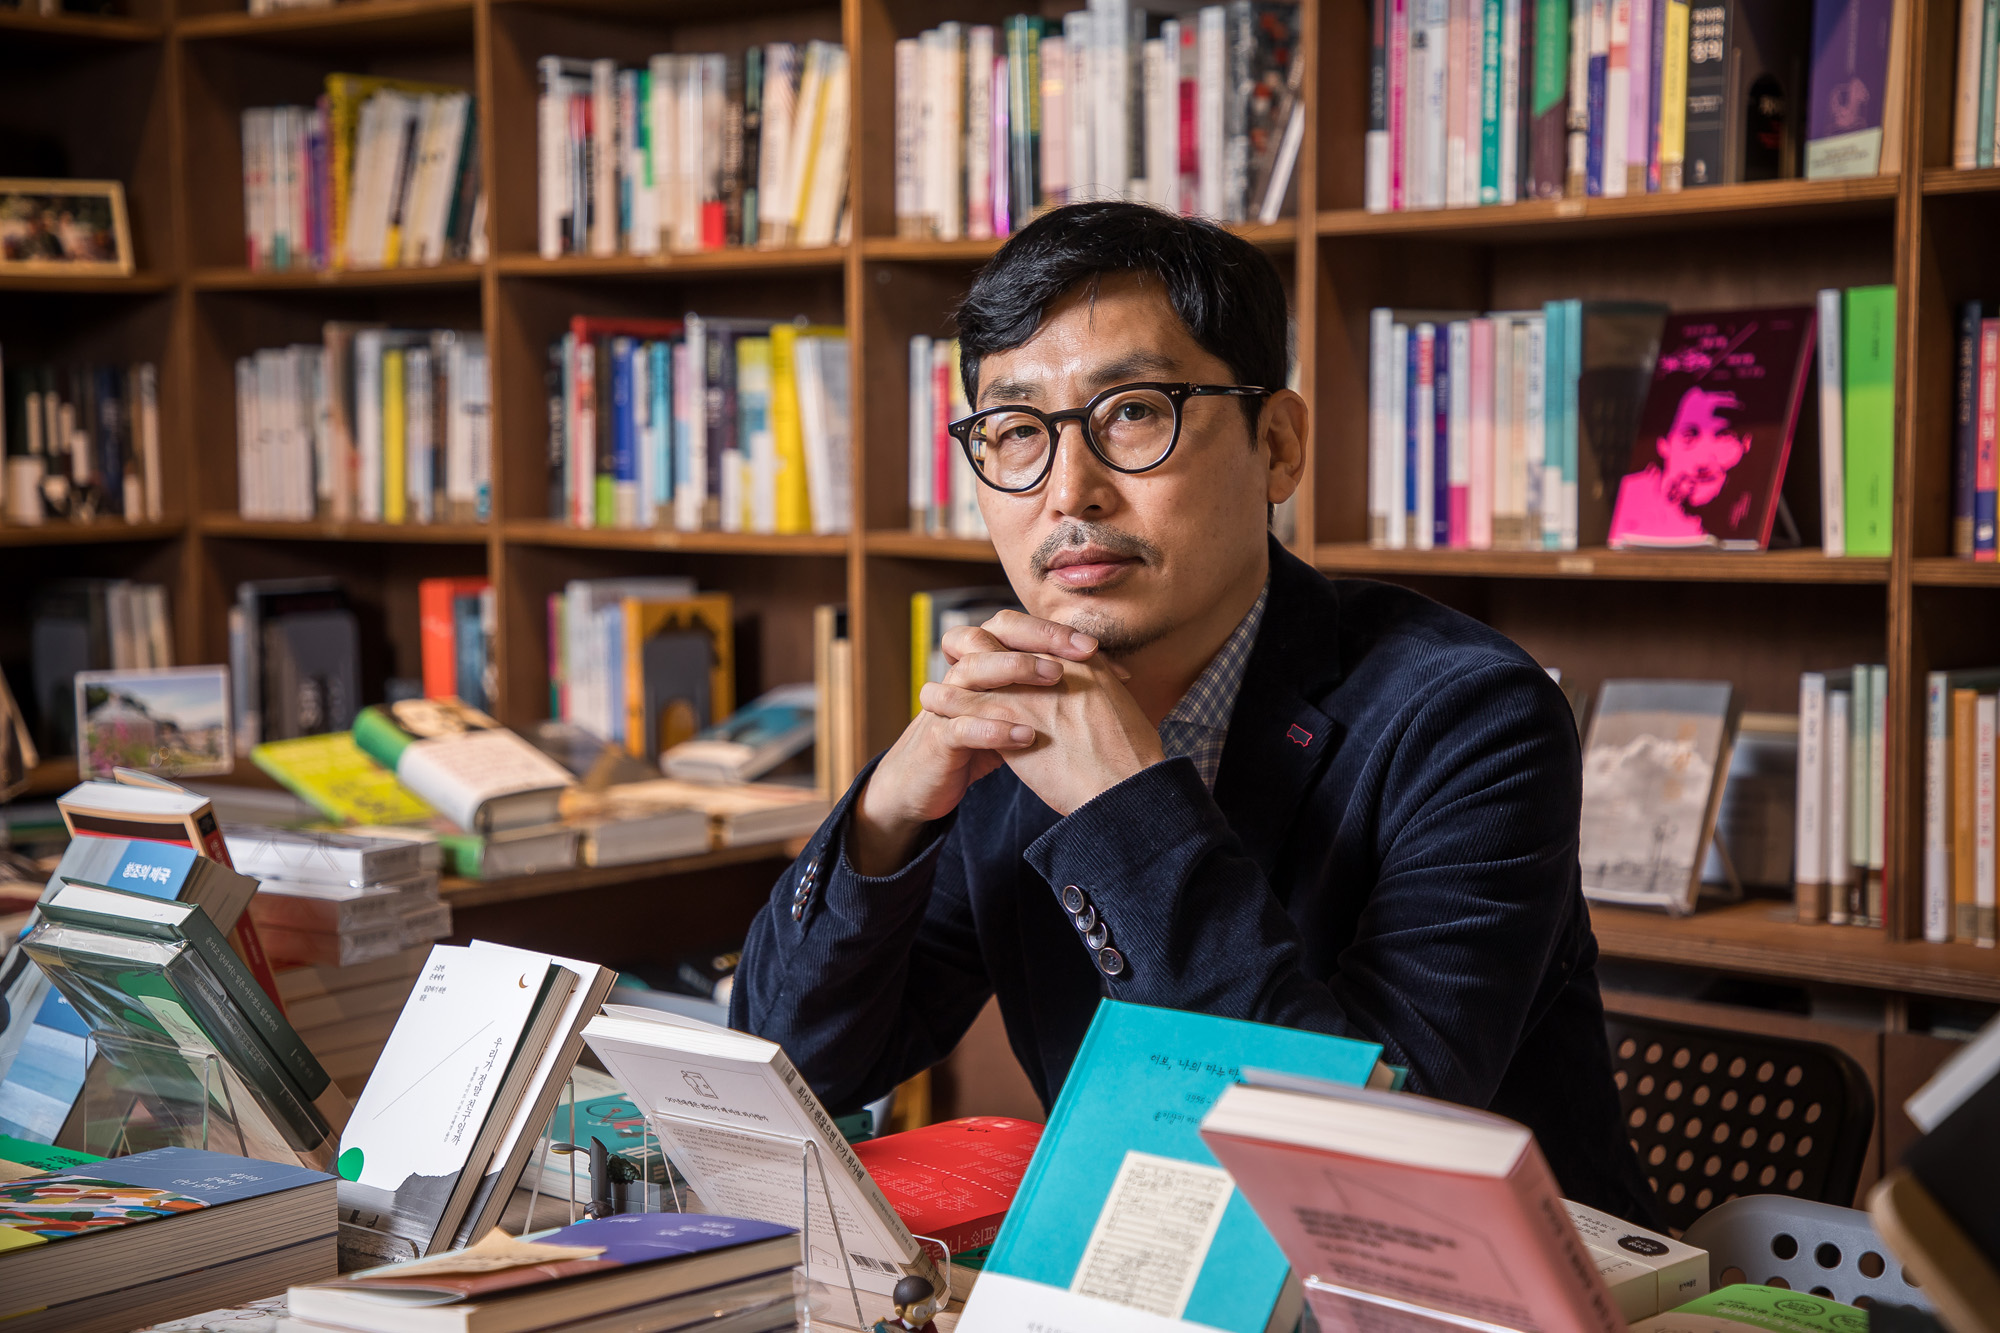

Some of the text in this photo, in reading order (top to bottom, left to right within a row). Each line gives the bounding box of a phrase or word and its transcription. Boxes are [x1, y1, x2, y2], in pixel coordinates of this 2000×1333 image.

[122, 862, 172, 885] 창조의 제국
[205, 936, 220, 954] 운다고
[218, 953, 237, 977] 달라지는
[235, 975, 247, 988] 일은
[244, 986, 262, 1011] 아무것도
[259, 1007, 279, 1033] 없겠지만
[483, 1037, 502, 1072] 우리가
[1178, 1059, 1202, 1073] 나의
[473, 1073, 487, 1097] 정말
[451, 1099, 477, 1146] 친구일까
[796, 1085, 866, 1183] 회사가 괜찮으면 누가 퇴사해
